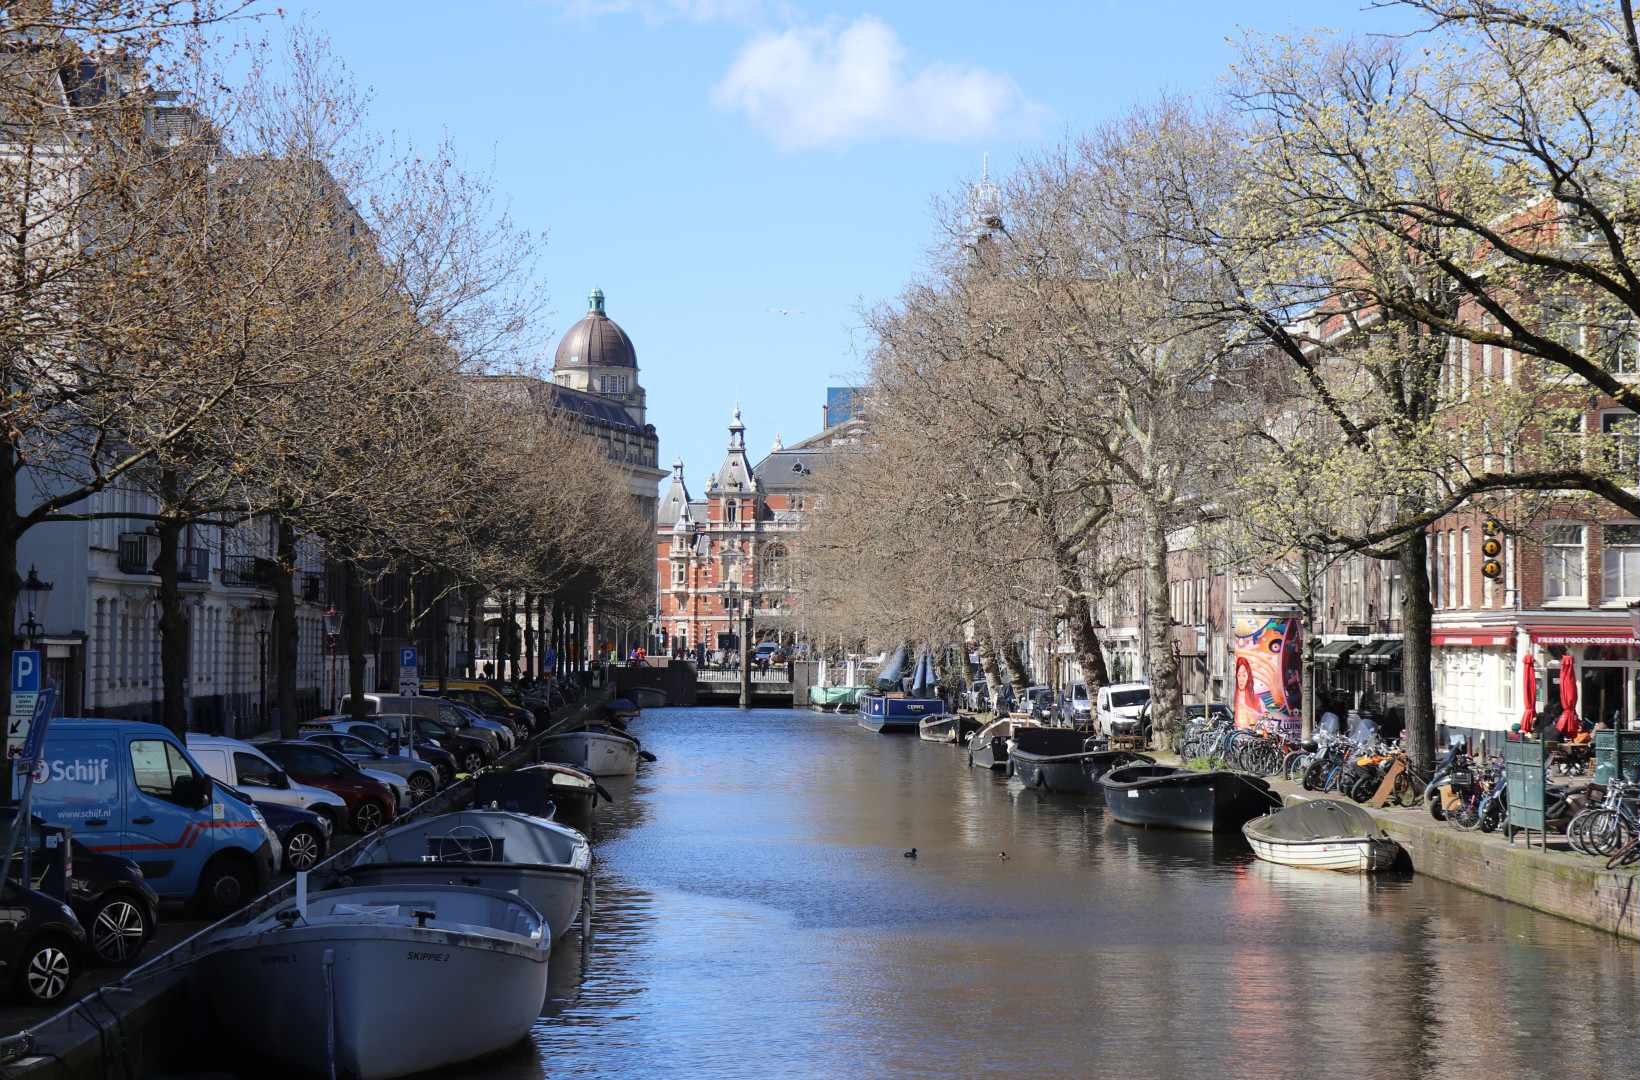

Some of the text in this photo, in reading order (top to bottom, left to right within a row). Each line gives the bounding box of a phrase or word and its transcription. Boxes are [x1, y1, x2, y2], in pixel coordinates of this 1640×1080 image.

[404, 650, 414, 665] P
[18, 656, 33, 688] P
[52, 758, 109, 786] Schijf
[57, 808, 111, 818] www.schijf.nl
[407, 951, 450, 962] SKIPPIE 2
